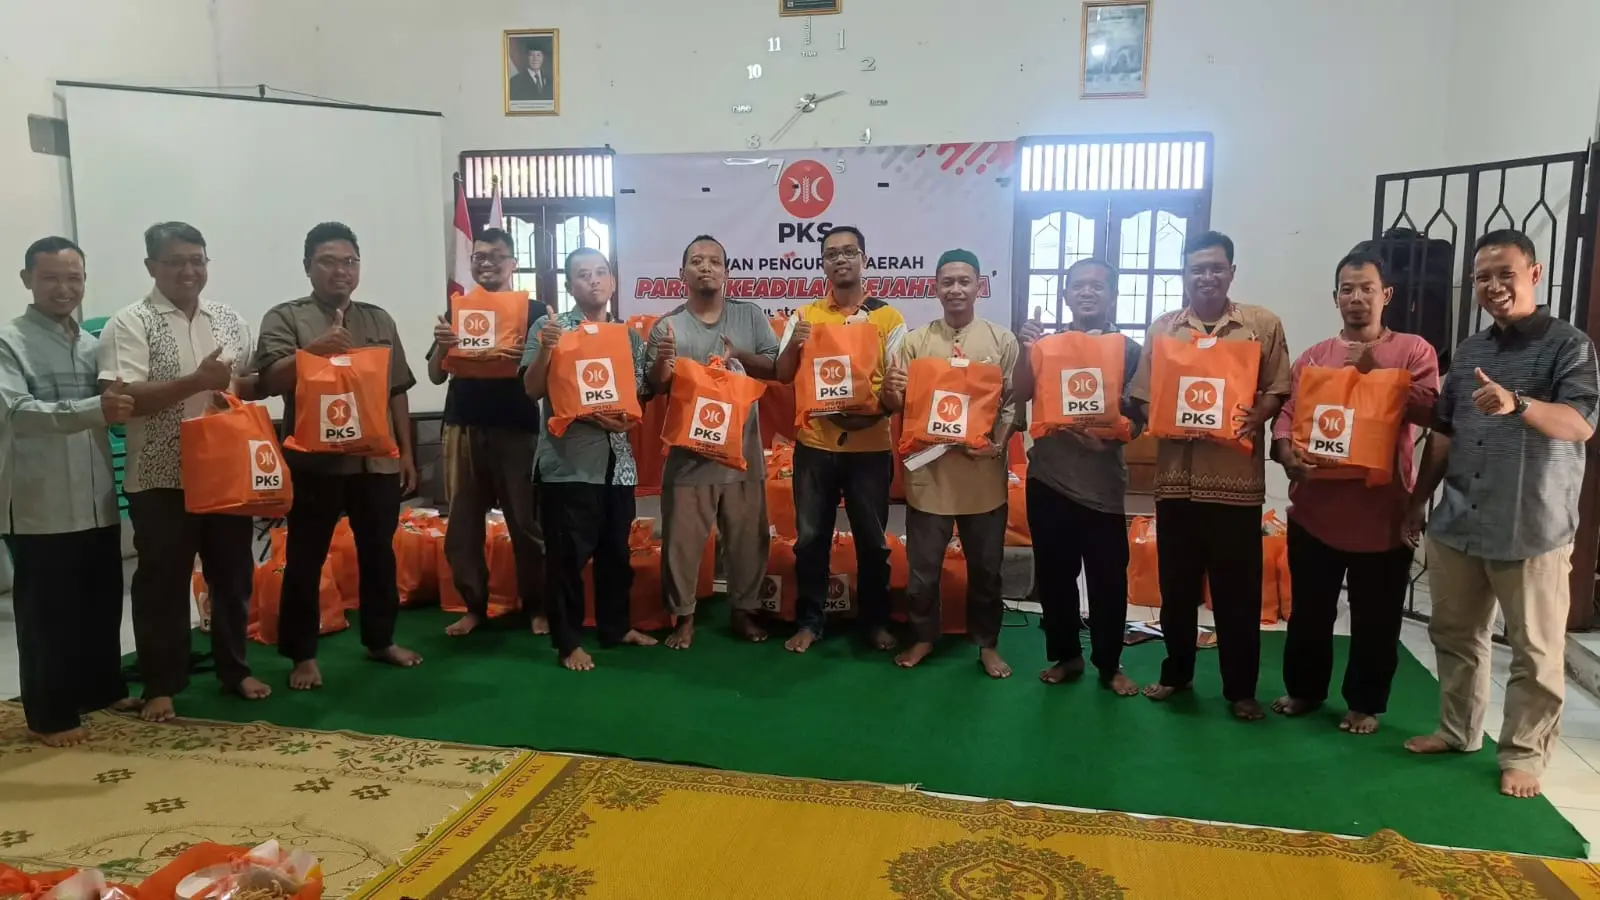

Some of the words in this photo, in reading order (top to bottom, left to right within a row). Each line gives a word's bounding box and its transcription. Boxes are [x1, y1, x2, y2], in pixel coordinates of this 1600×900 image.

[768, 36, 781, 52] 11
[860, 56, 877, 72] 2
[746, 64, 762, 80] 10
[746, 134, 761, 149] 8
[767, 158, 785, 185] 7
[759, 257, 825, 270] PENGUR
[866, 256, 924, 270] AERAH
[724, 277, 834, 299] KEADILA
[462, 338, 490, 347] PKS
[585, 389, 614, 402] PKS
[820, 386, 848, 398] PKS
[1068, 400, 1100, 412] PKS
[1182, 412, 1216, 426] PKS
[326, 426, 356, 439] PKS
[694, 427, 722, 442] PKS
[932, 422, 962, 434] PKS
[1314, 440, 1344, 454] PKS
[256, 475, 280, 487] PKS
[398, 847, 453, 884] SANTRI
[456, 806, 498, 838] BRAND
[500, 763, 545, 799] SPECIAL
